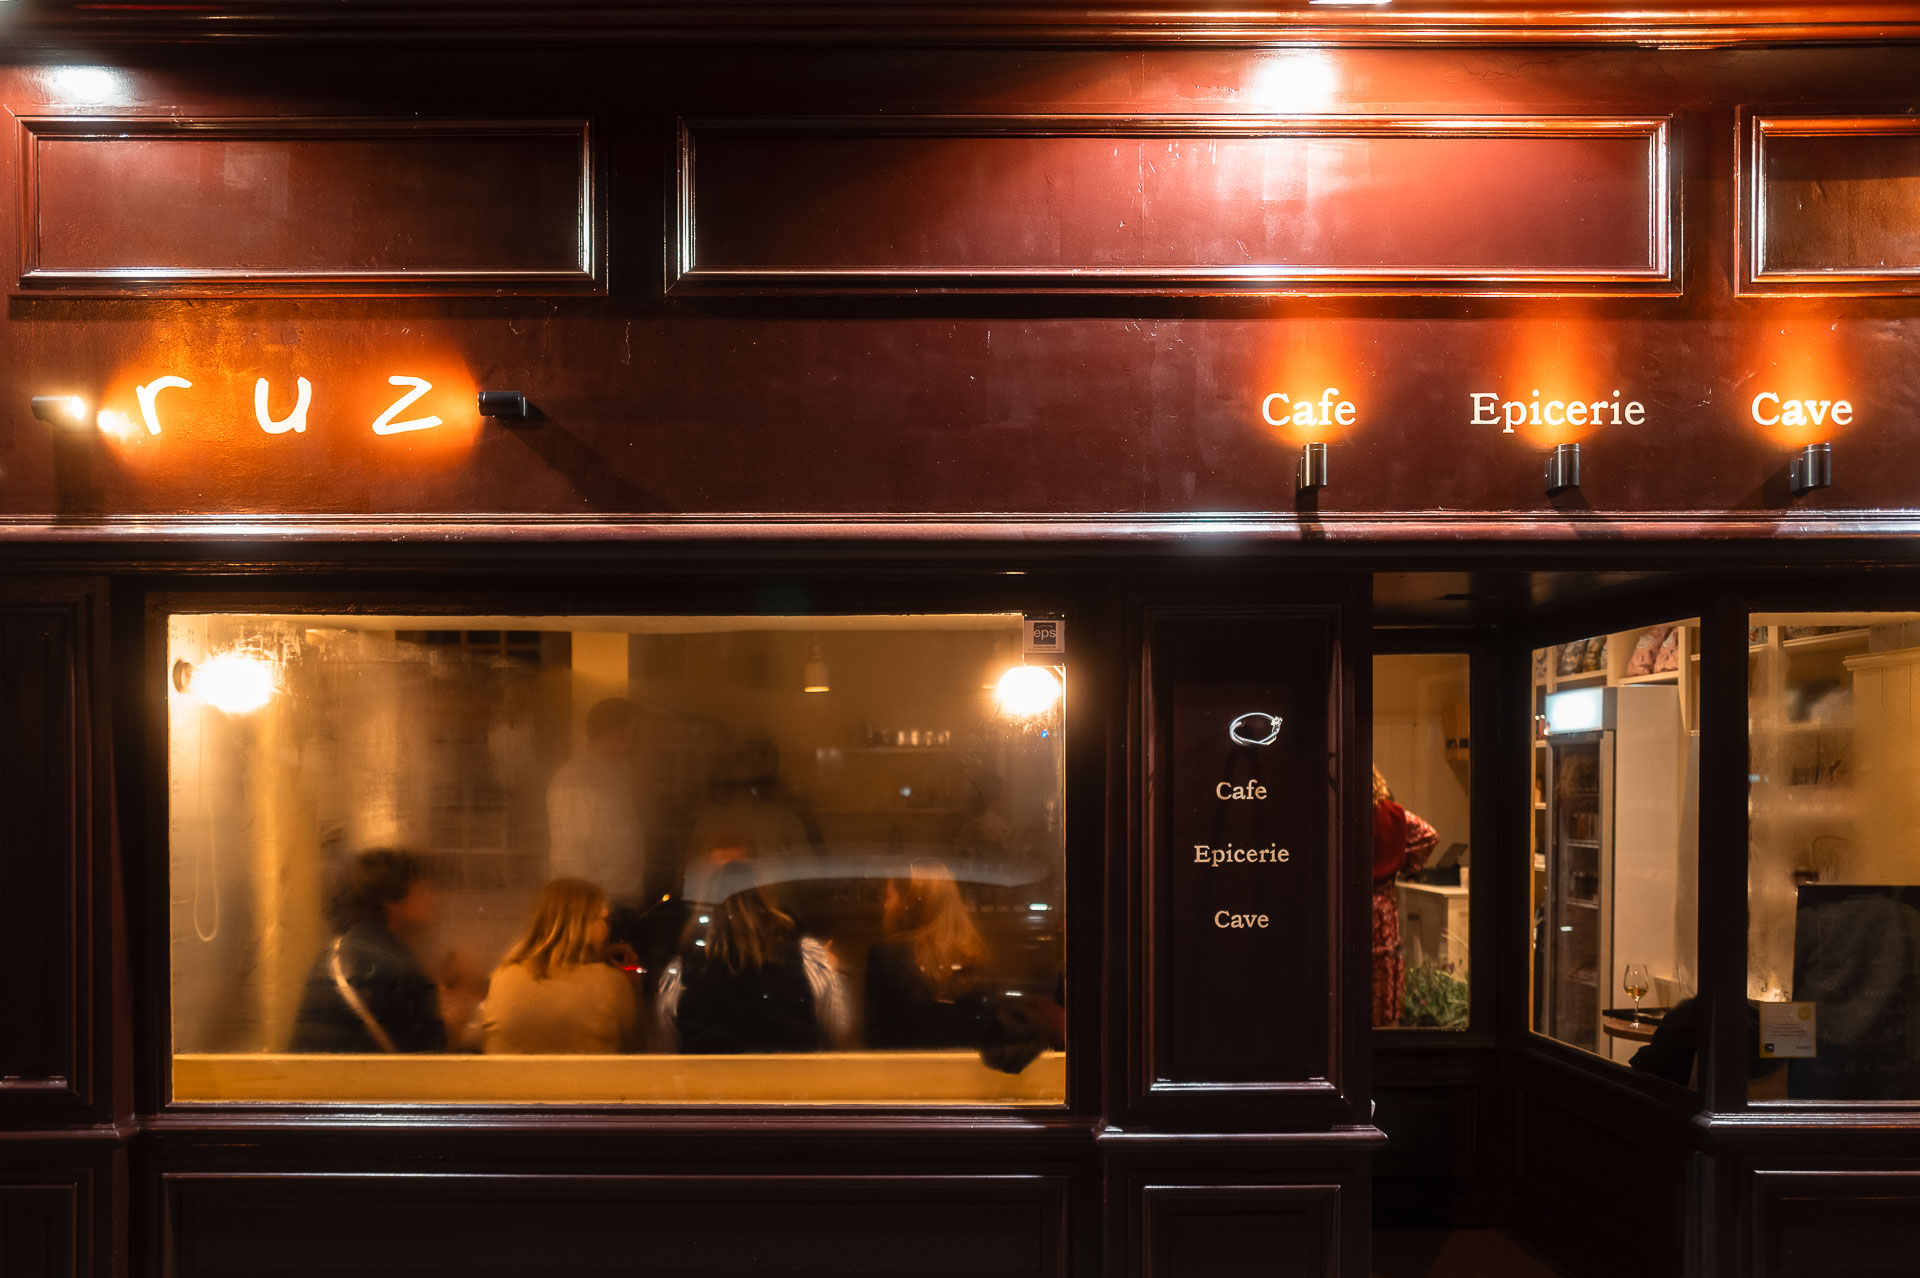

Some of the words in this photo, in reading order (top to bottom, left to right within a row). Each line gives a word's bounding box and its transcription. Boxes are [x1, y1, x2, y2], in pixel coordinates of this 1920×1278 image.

[1261, 387, 1356, 427] Cafe
[1469, 388, 1646, 434] Epicerie
[1751, 391, 1853, 427] Cave
[1033, 629, 1056, 641] eps
[1215, 779, 1268, 801] Cafe
[1193, 843, 1290, 867] Epicerie
[1213, 910, 1270, 929] Cave
